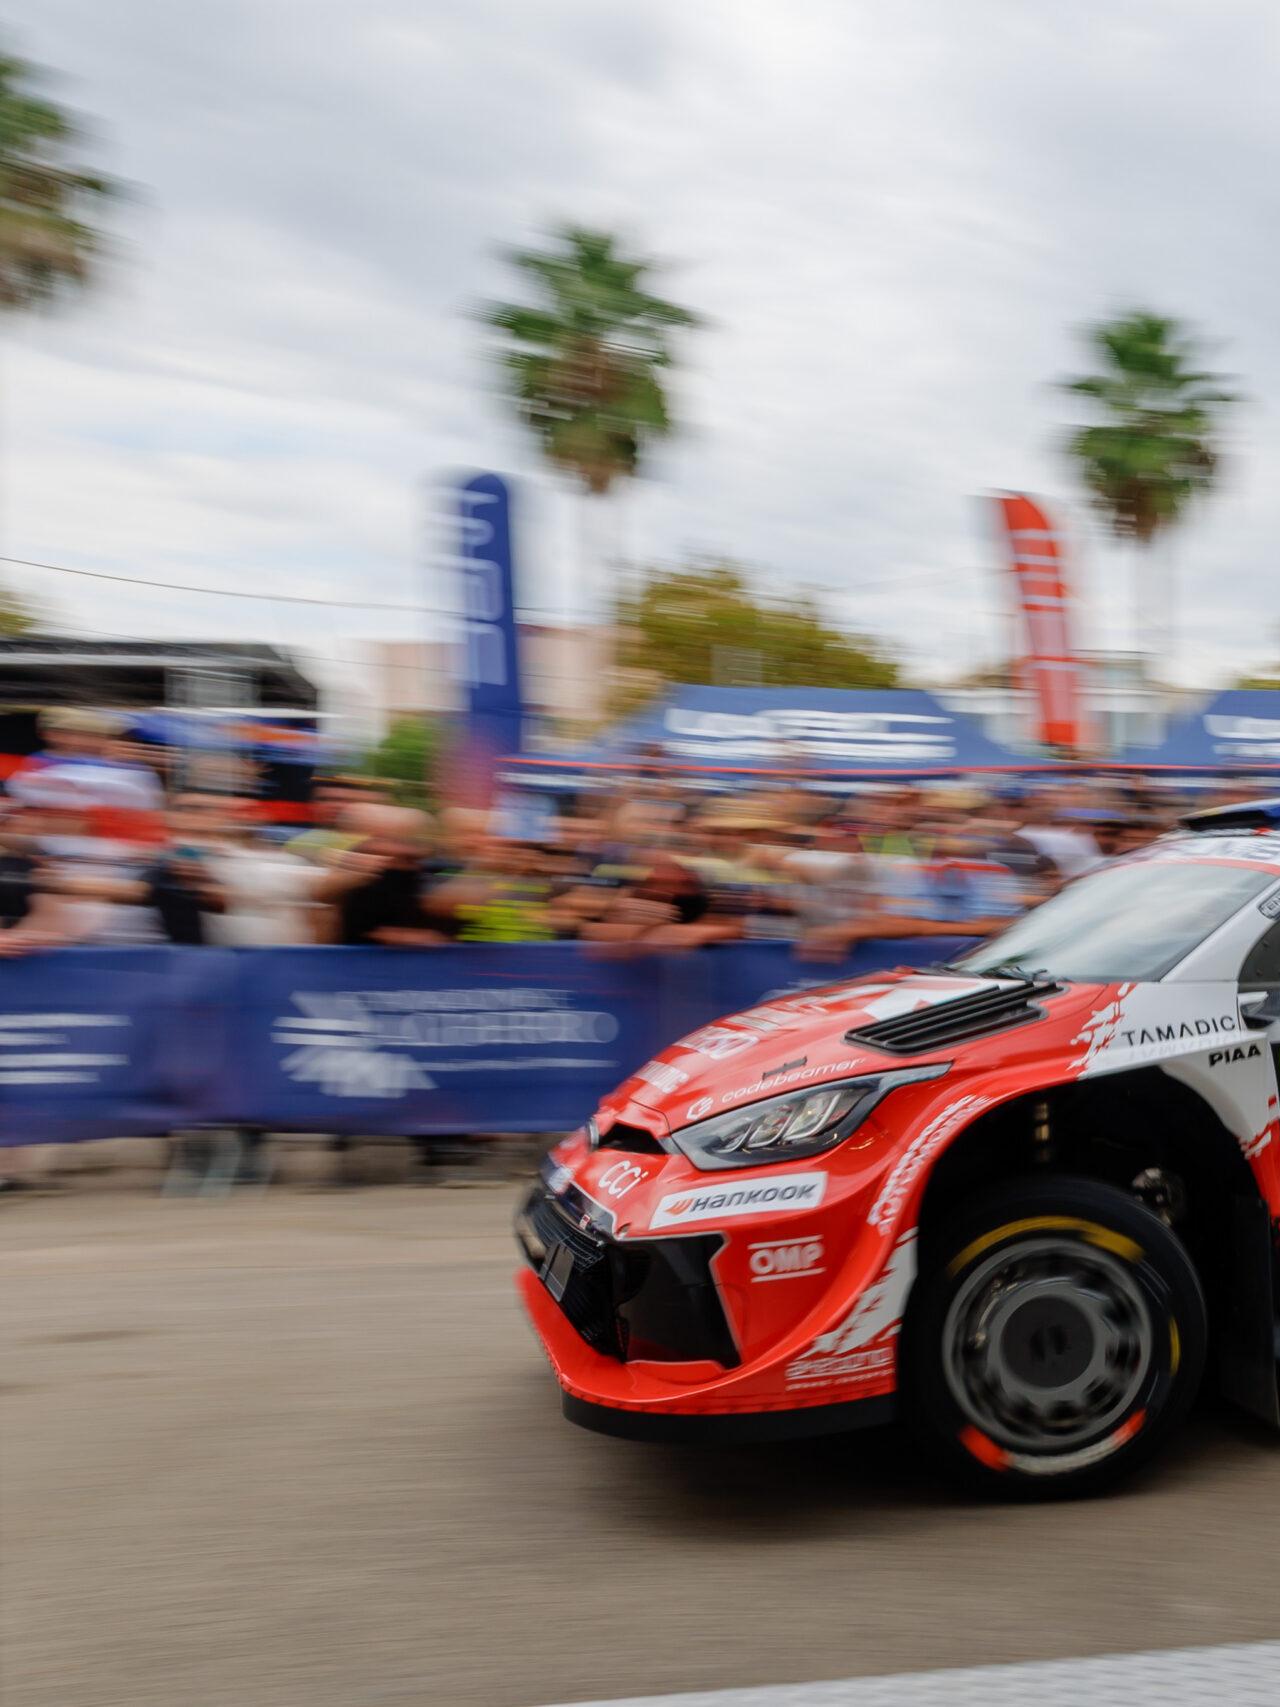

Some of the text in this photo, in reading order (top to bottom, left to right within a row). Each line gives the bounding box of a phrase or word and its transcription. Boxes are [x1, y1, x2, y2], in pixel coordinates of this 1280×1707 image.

[1121, 1015, 1236, 1047] TAMADIC
[1208, 1043, 1261, 1068] PIAA
[721, 1058, 861, 1103] codebeamer
[750, 1243, 825, 1274] OMP
